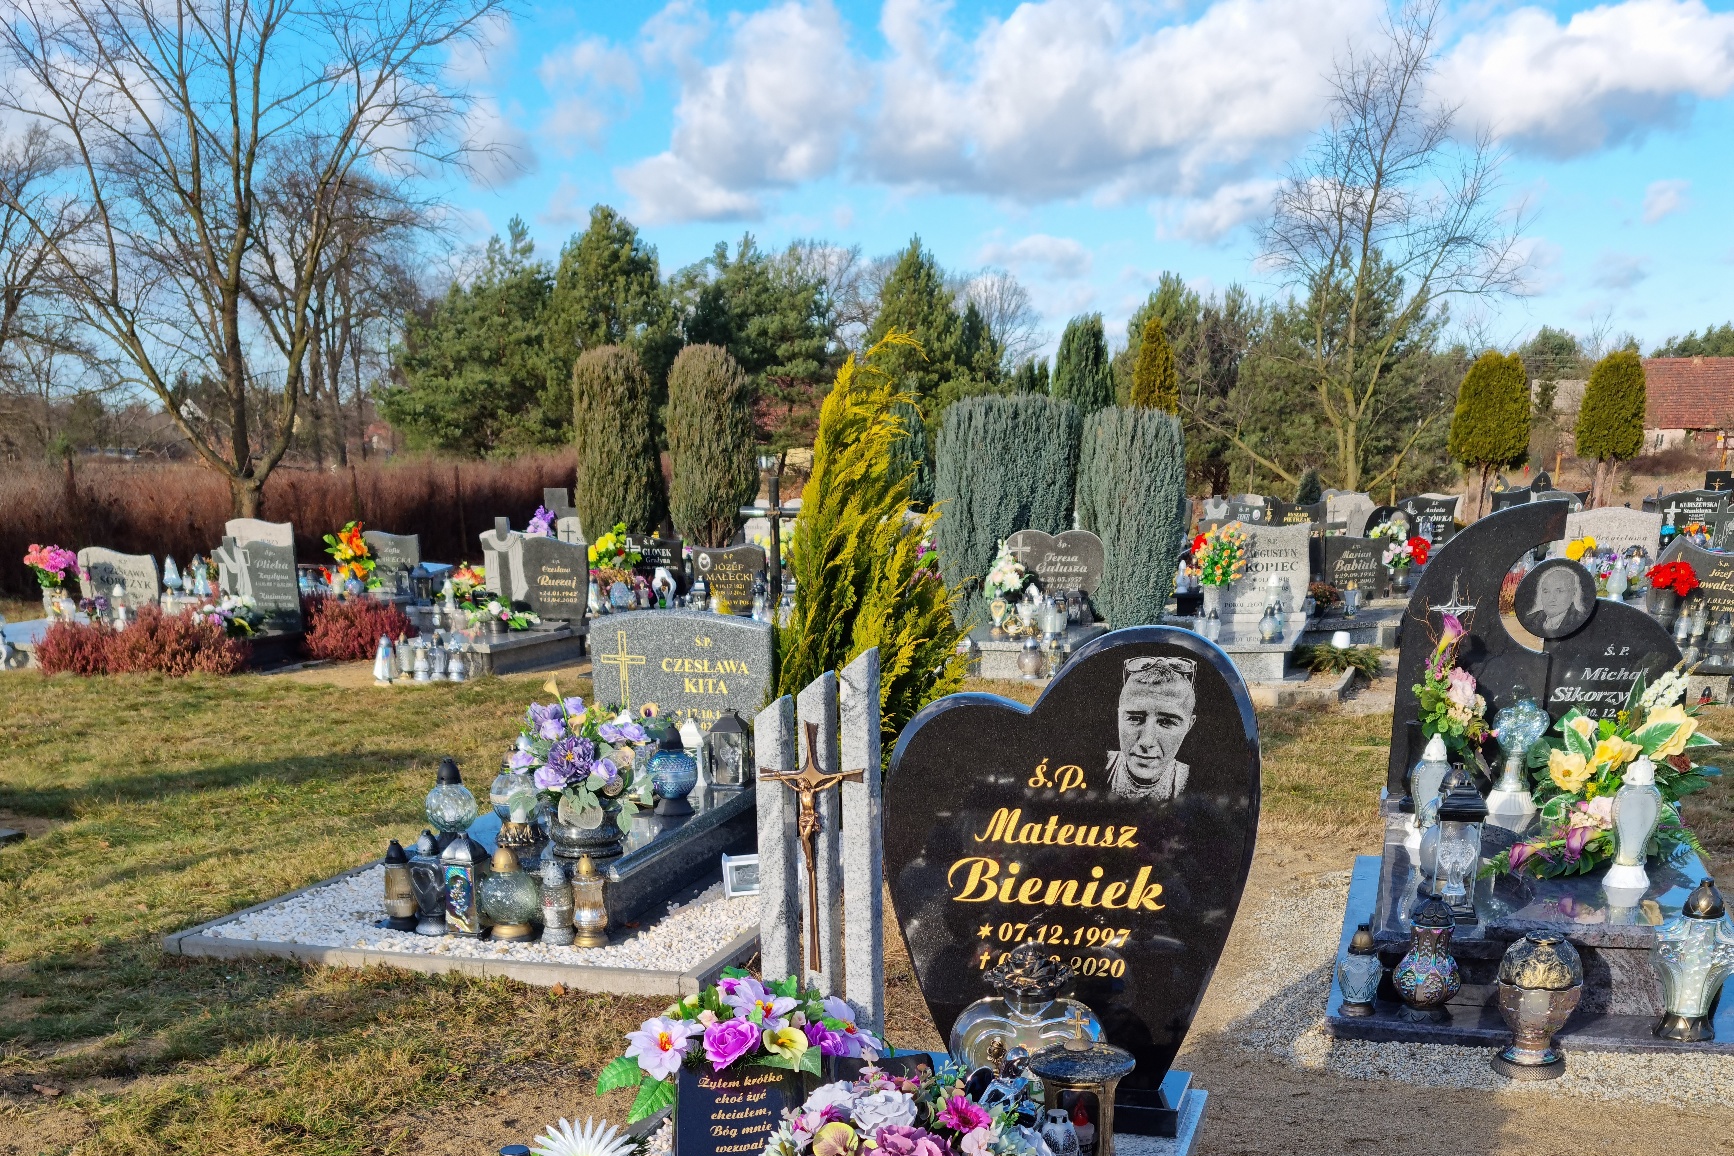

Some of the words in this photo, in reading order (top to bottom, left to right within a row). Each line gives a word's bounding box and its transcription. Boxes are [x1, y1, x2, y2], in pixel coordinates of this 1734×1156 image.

[1044, 553, 1079, 562] Teresa
[1249, 549, 1299, 560] AUGUSTYN
[714, 562, 745, 571] JÓZEF
[1245, 562, 1299, 573] KOPIEC
[706, 573, 754, 581] MAŁECKI
[1709, 569, 1734, 580] Józef
[684, 678, 728, 694] KITA
[974, 807, 1139, 848] Mateusz
[948, 857, 1166, 911] Bieniek
[998, 922, 1132, 948] 07.12.1997
[744, 1072, 784, 1086] krótko
[715, 1093, 744, 1104] choć
[746, 1090, 767, 1103] żyć
[710, 1125, 738, 1138] Bóg
[741, 1121, 773, 1134] mnie
